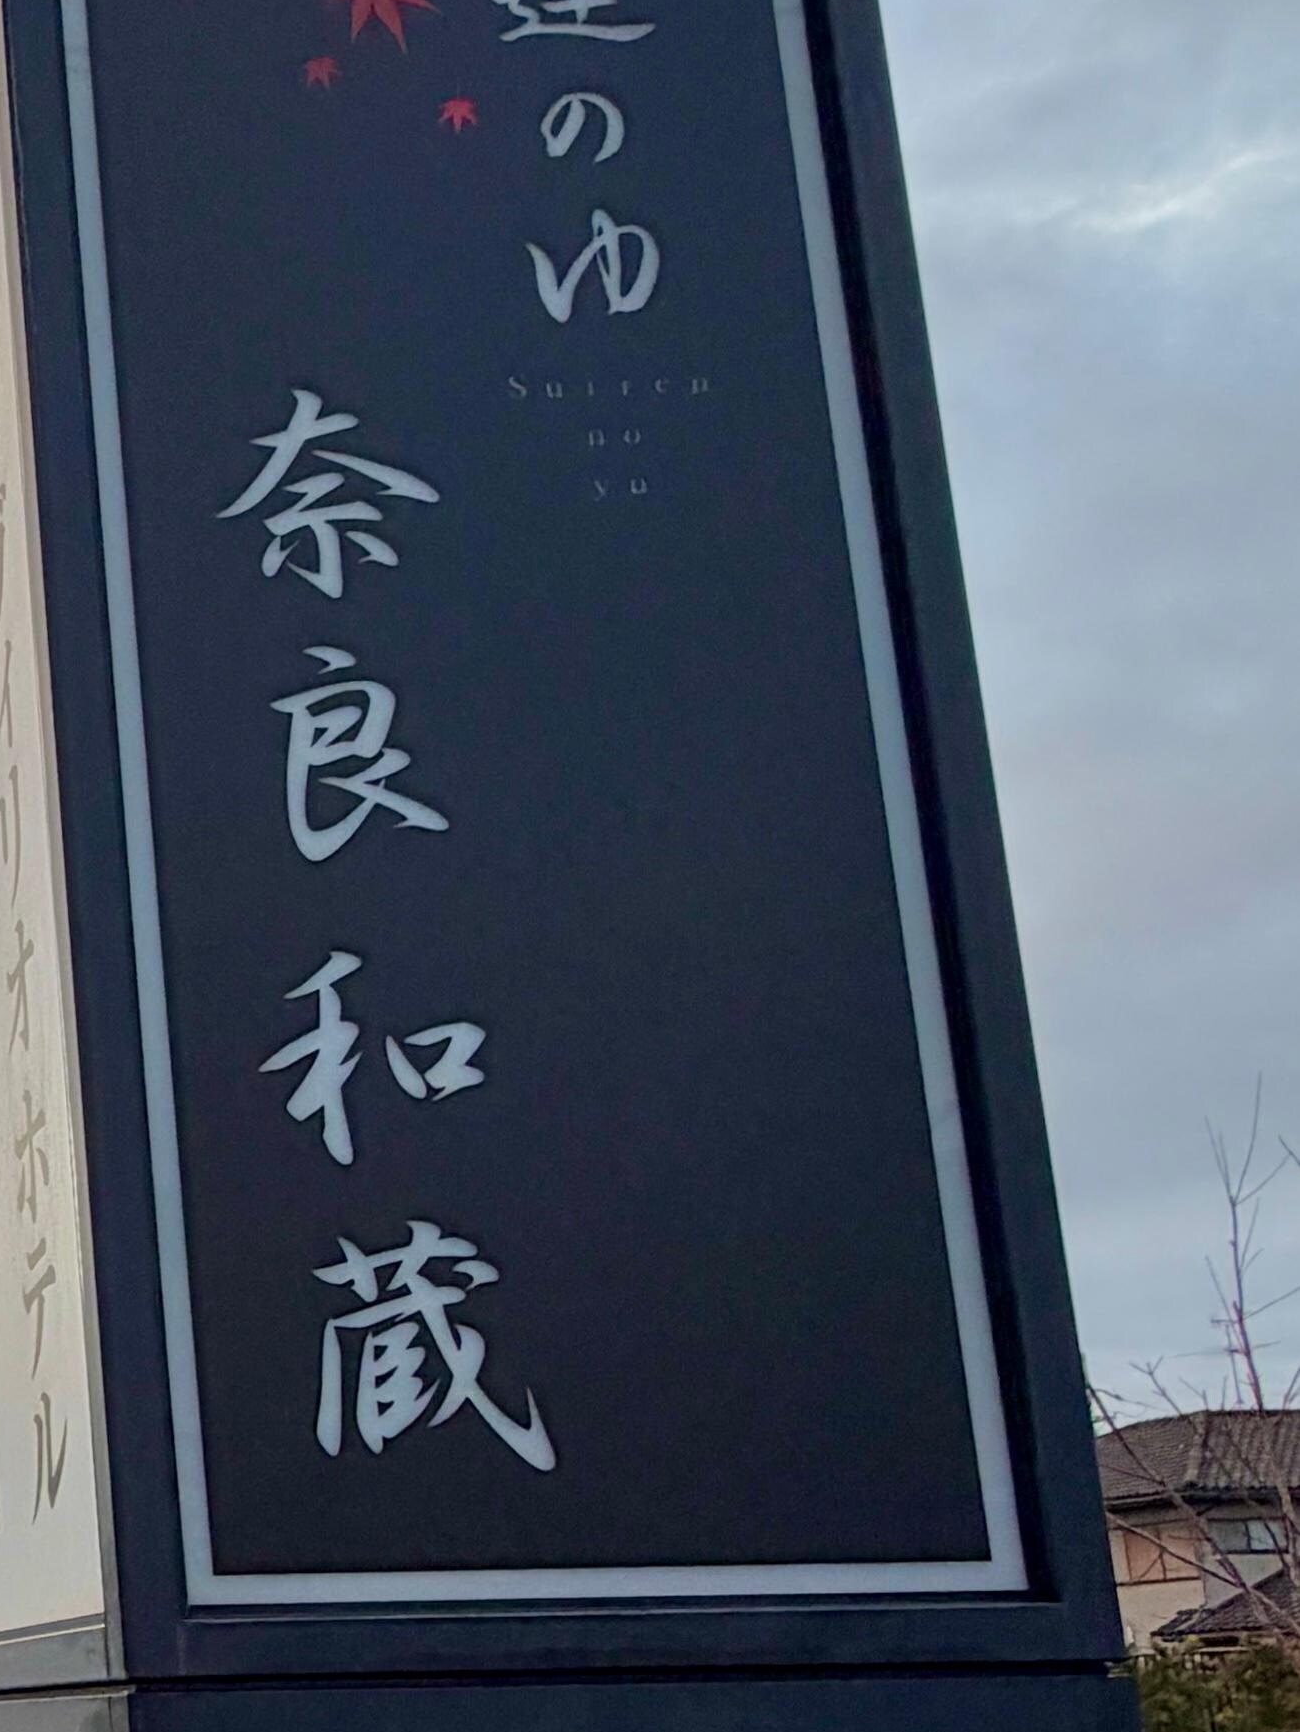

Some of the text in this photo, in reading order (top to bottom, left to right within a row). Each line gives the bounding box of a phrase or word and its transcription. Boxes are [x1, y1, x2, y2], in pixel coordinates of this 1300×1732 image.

[507, 376, 710, 399] Suiren
[587, 429, 642, 446] no
[594, 477, 648, 502] yu
[214, 388, 557, 1473] 奈良和蔵
